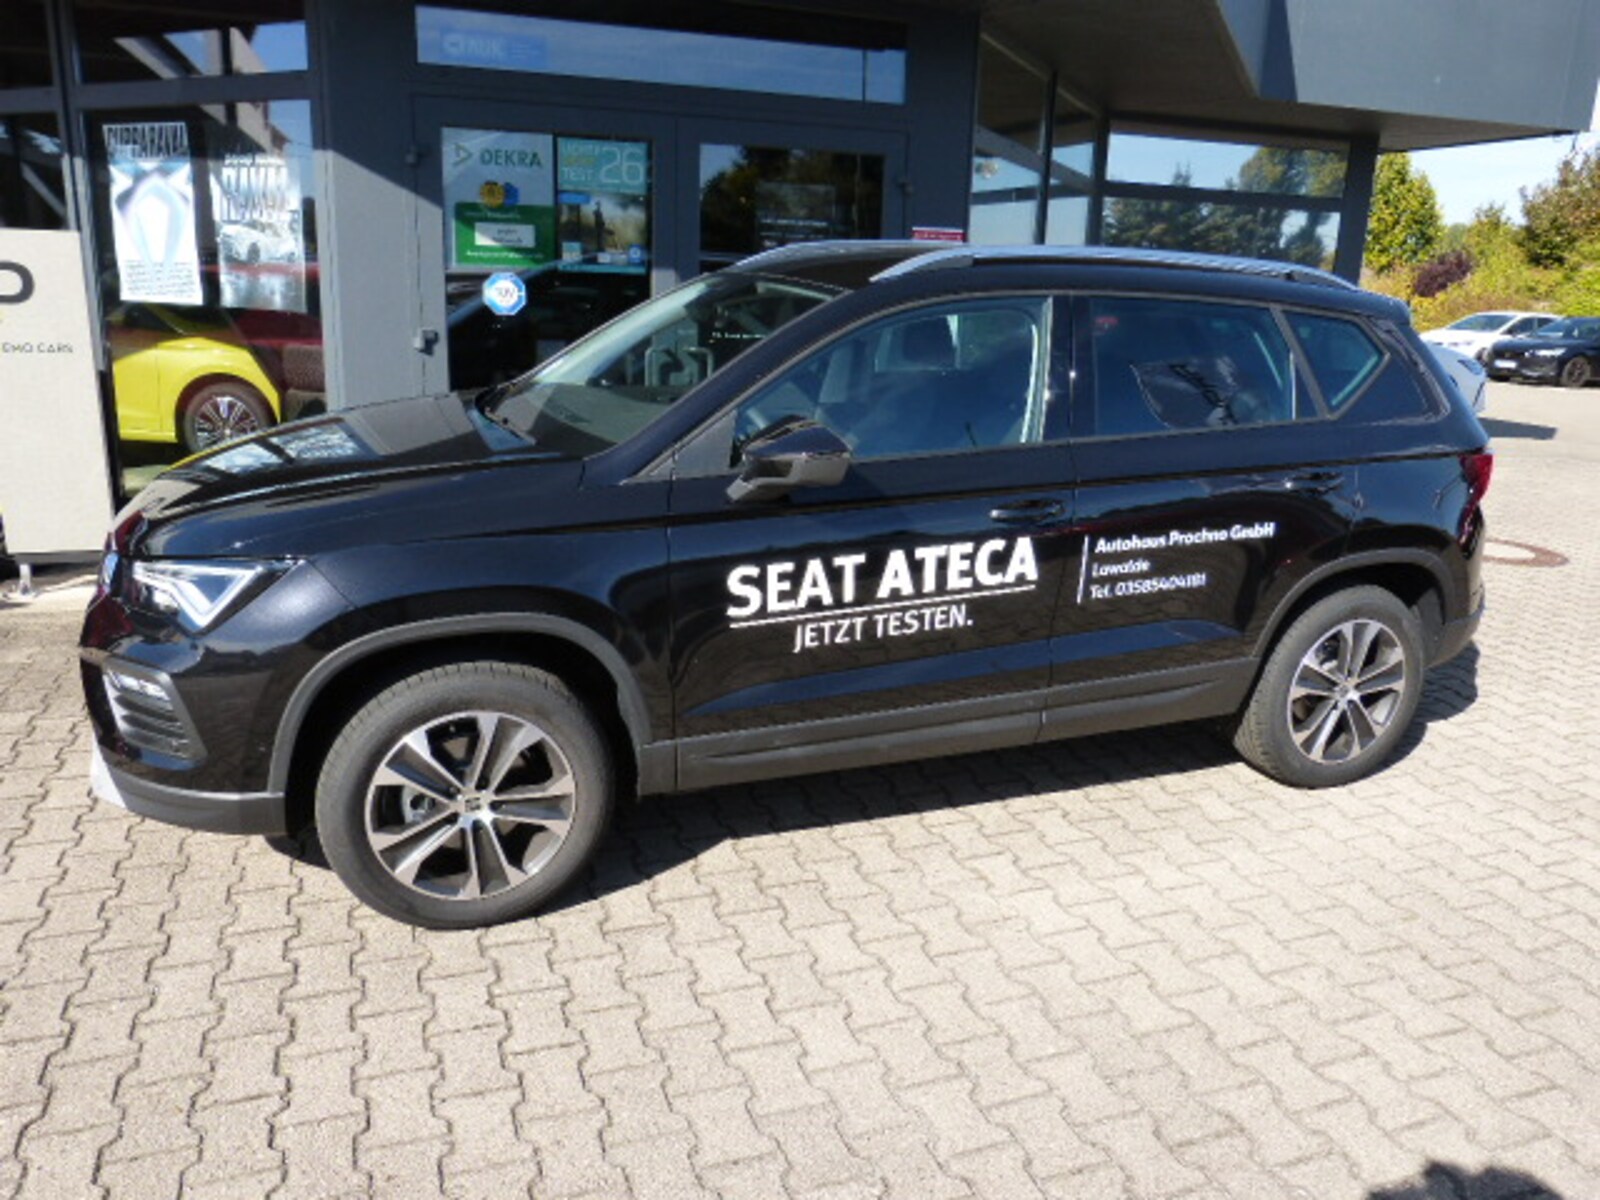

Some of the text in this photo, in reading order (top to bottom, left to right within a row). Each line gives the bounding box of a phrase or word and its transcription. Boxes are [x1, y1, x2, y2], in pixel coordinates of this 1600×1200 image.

[480, 148, 544, 168] DEKRA
[1095, 521, 1276, 554] Autohaus Prochno GmbH
[726, 536, 1039, 617] SEAT ATECA
[1092, 558, 1151, 578] Lawalde
[1089, 583, 1113, 599] Tel.
[792, 604, 974, 654] JETZT TESTEN.
